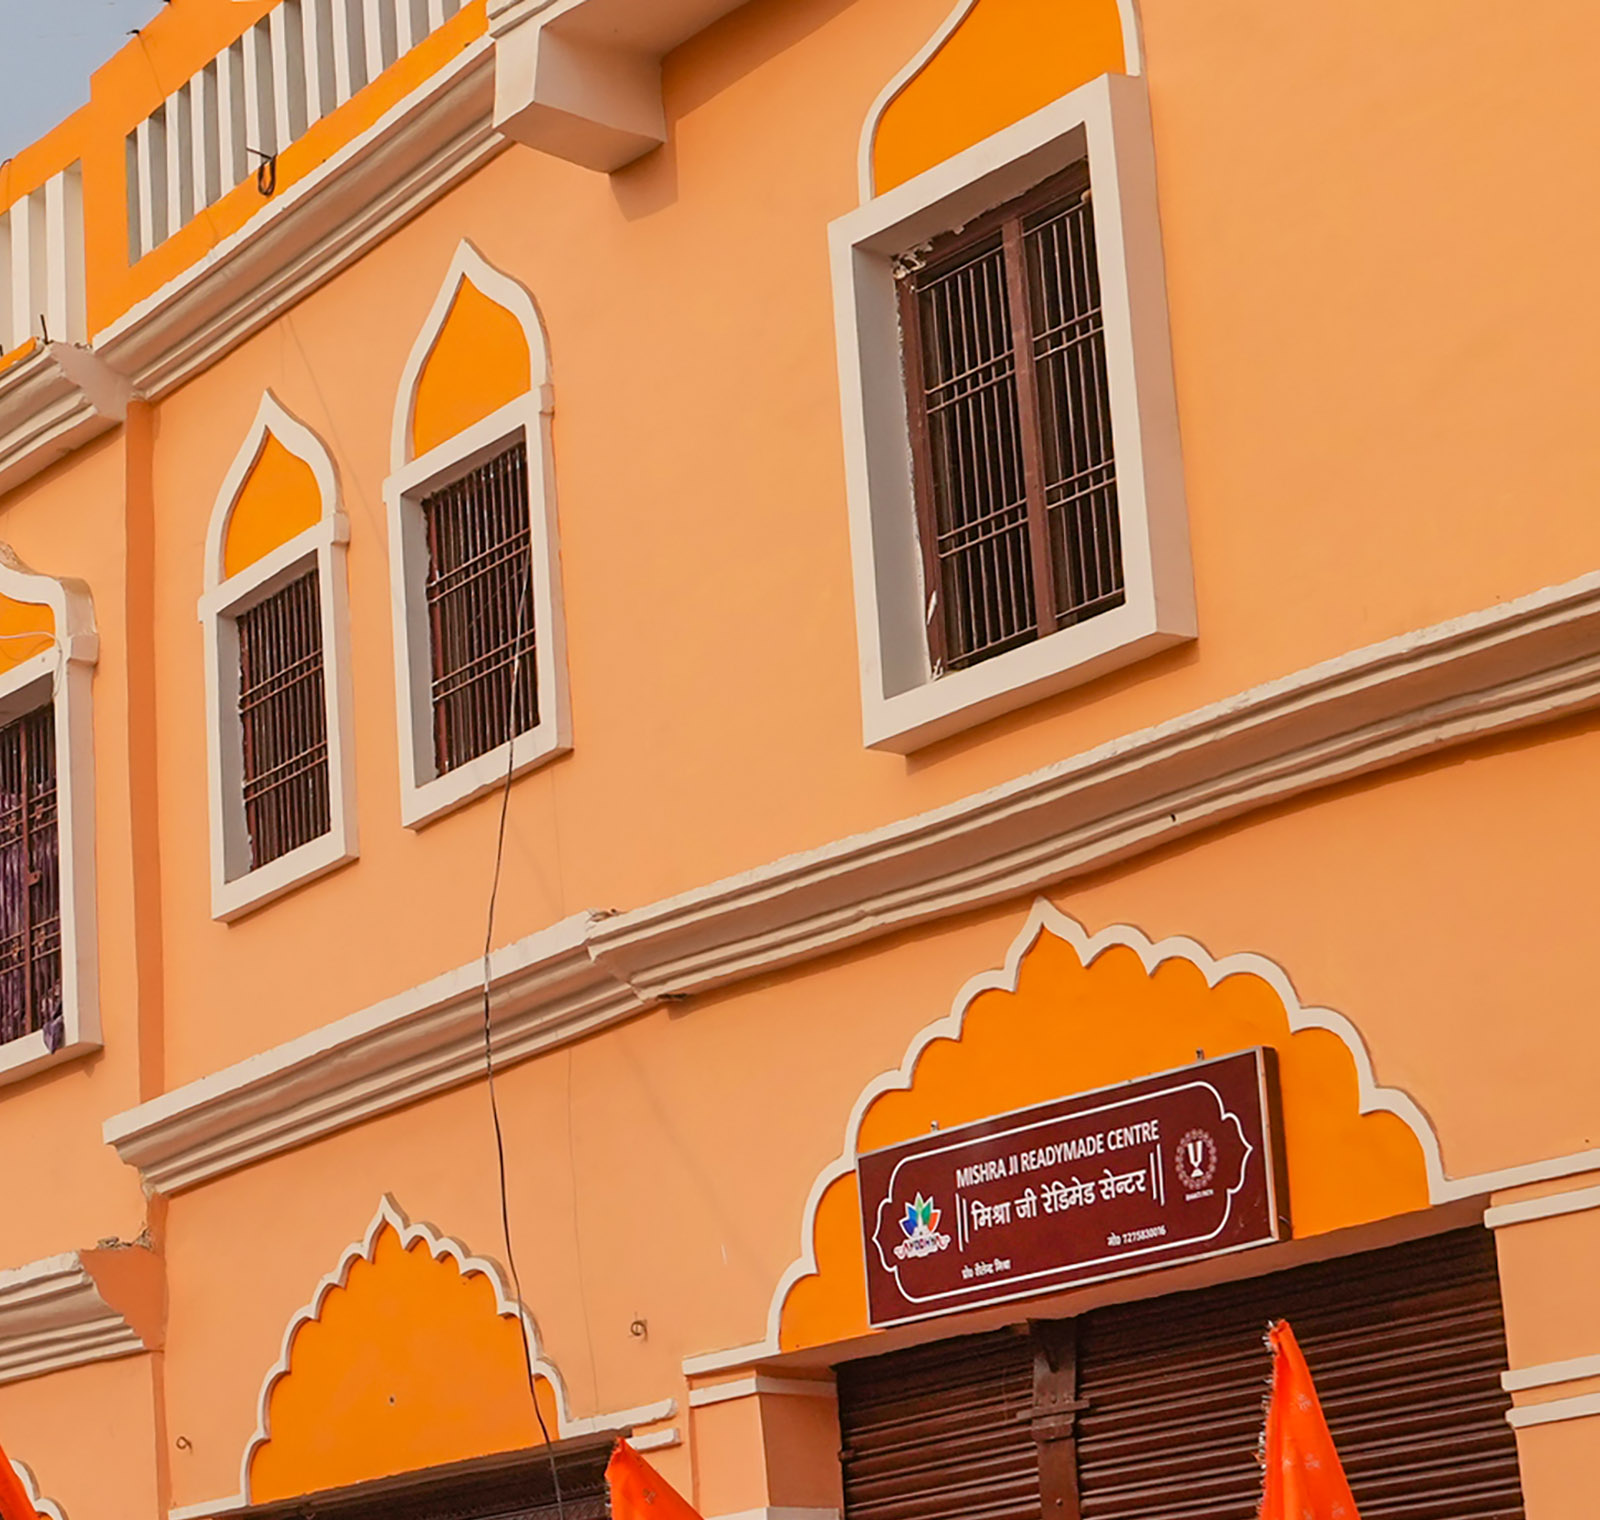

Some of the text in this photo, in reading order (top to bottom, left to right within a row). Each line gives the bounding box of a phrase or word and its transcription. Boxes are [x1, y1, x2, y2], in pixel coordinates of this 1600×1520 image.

[956, 1120, 1160, 1188] MISHRA JI READYMADE CENTRE
[971, 1169, 1147, 1230] मिश्रा जी रेडिमेड सेन्टर
